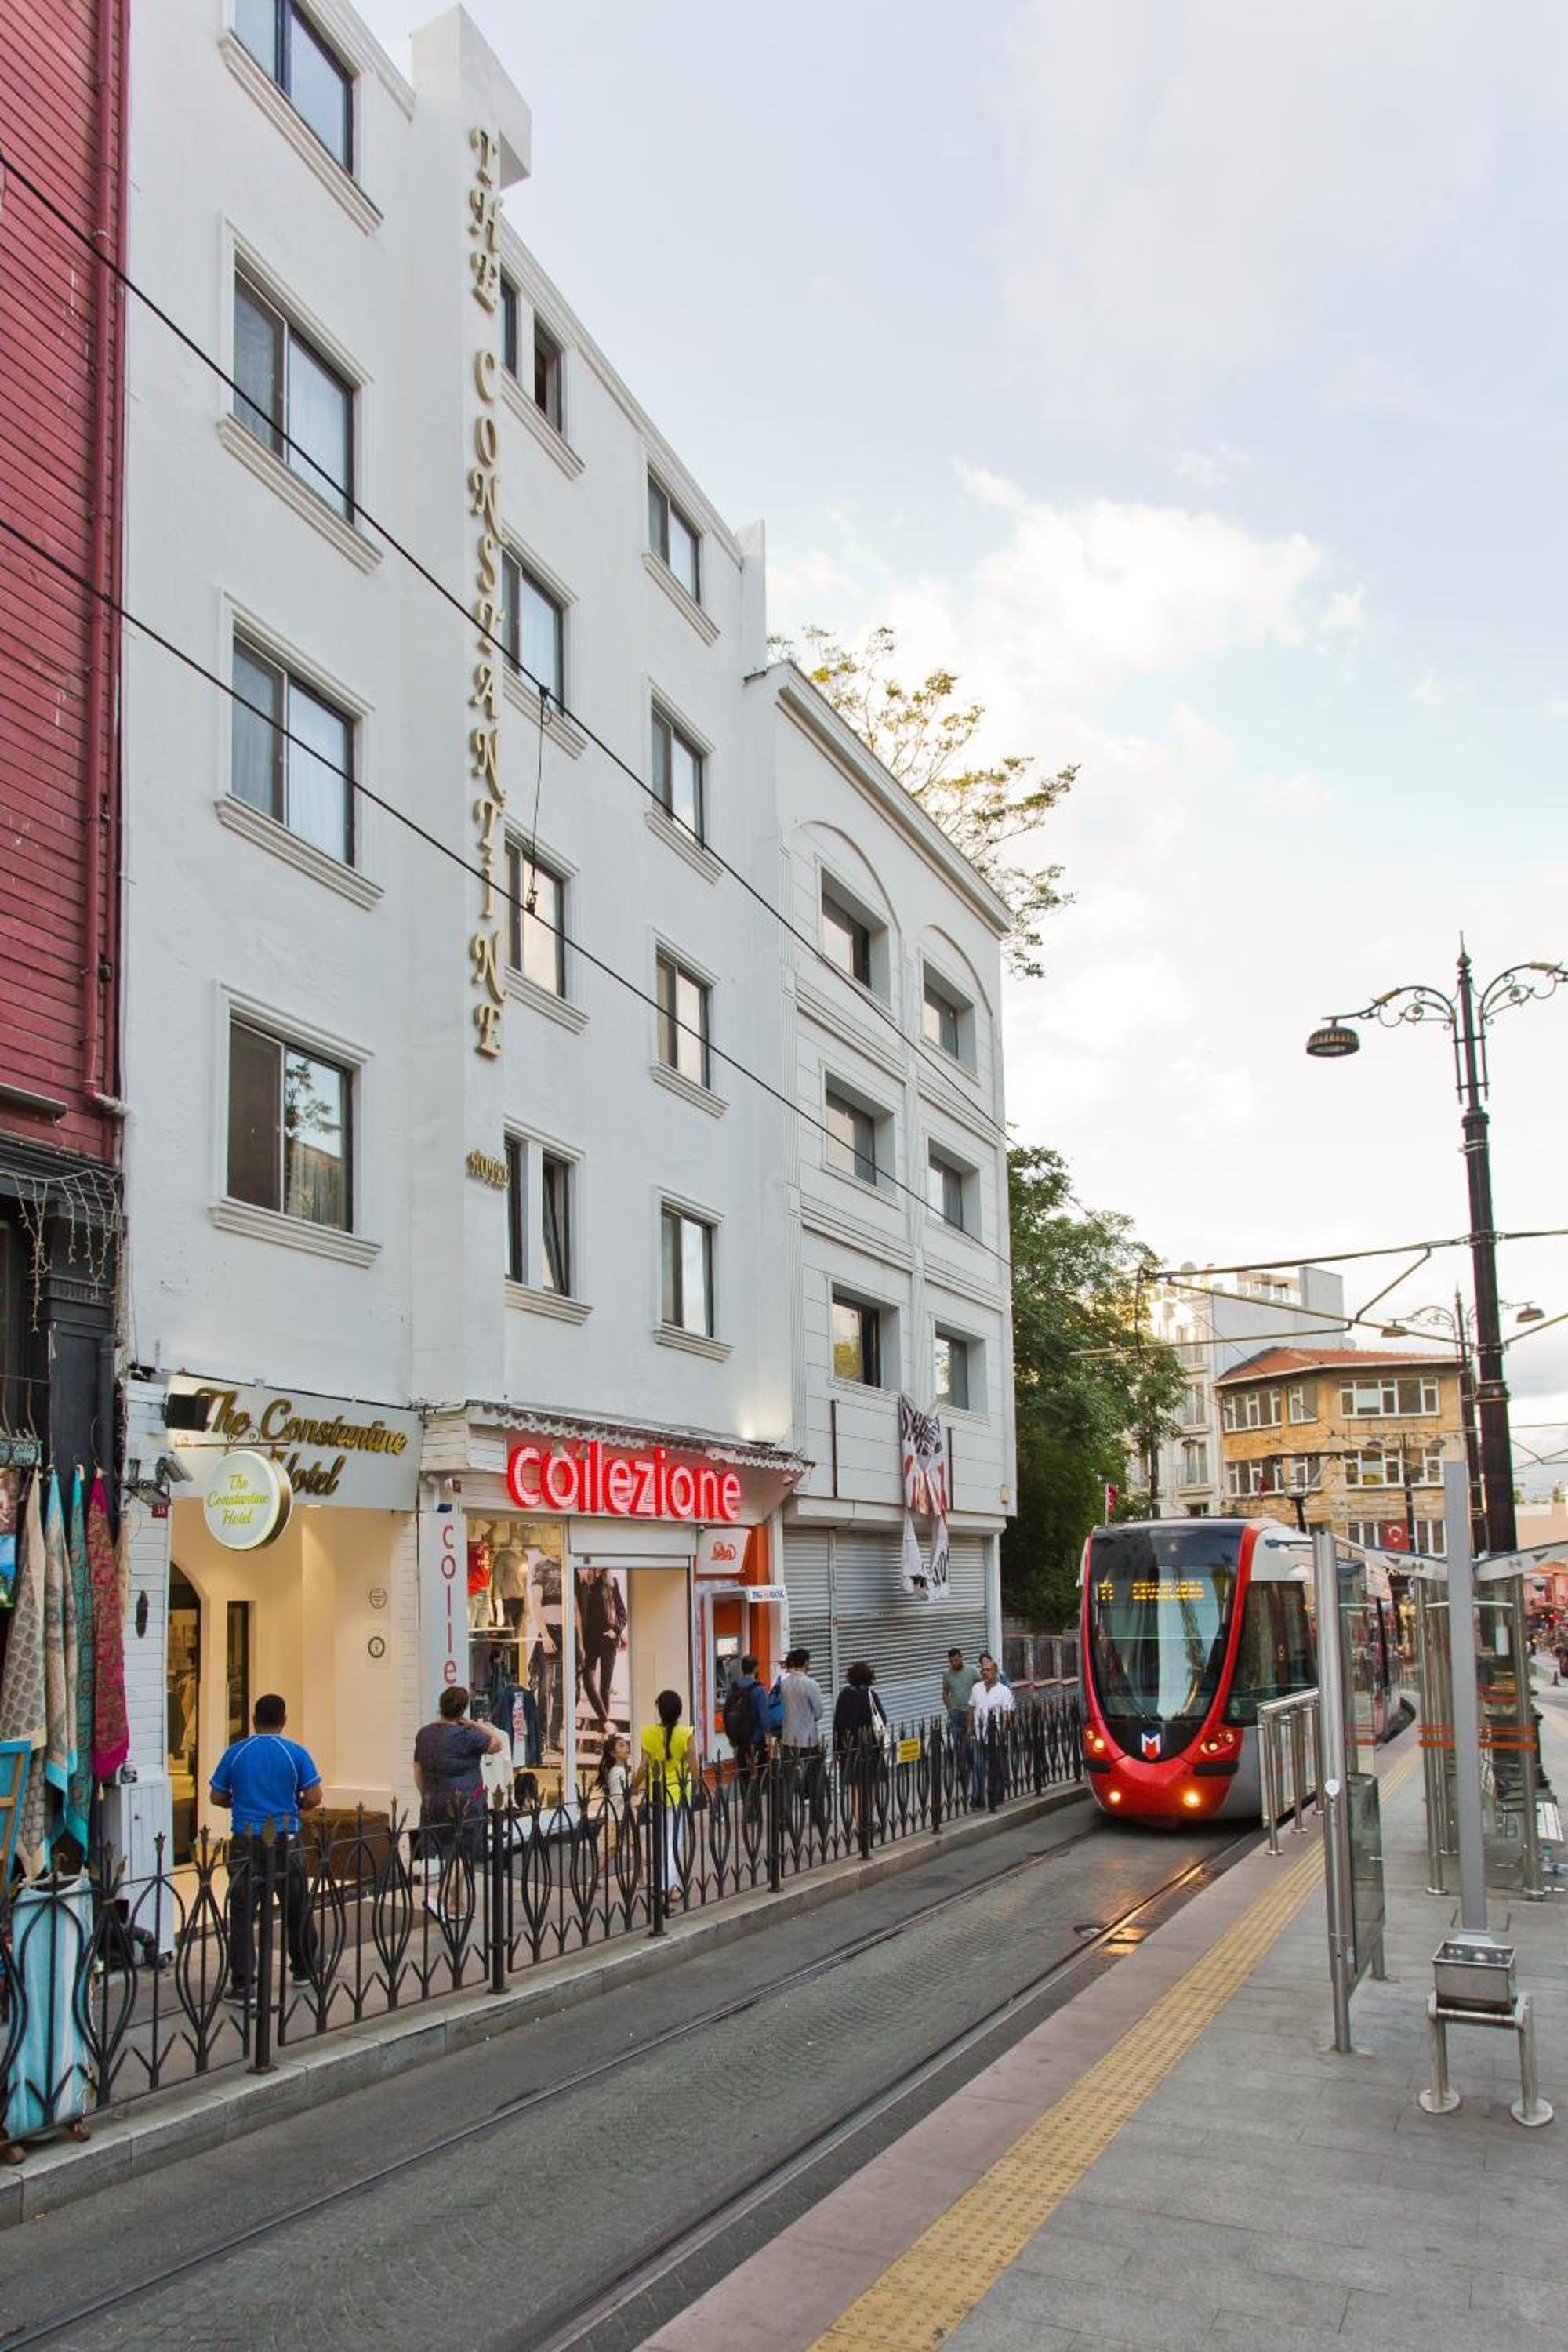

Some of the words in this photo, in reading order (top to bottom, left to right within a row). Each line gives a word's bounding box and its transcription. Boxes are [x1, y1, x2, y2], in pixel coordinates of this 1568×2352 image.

[469, 125, 503, 313] THE
[195, 1387, 252, 1434] The
[261, 1398, 408, 1455] Constantine
[227, 1473, 248, 1490] The
[208, 1490, 270, 1507] Constantine
[223, 1508, 252, 1526] Hotel
